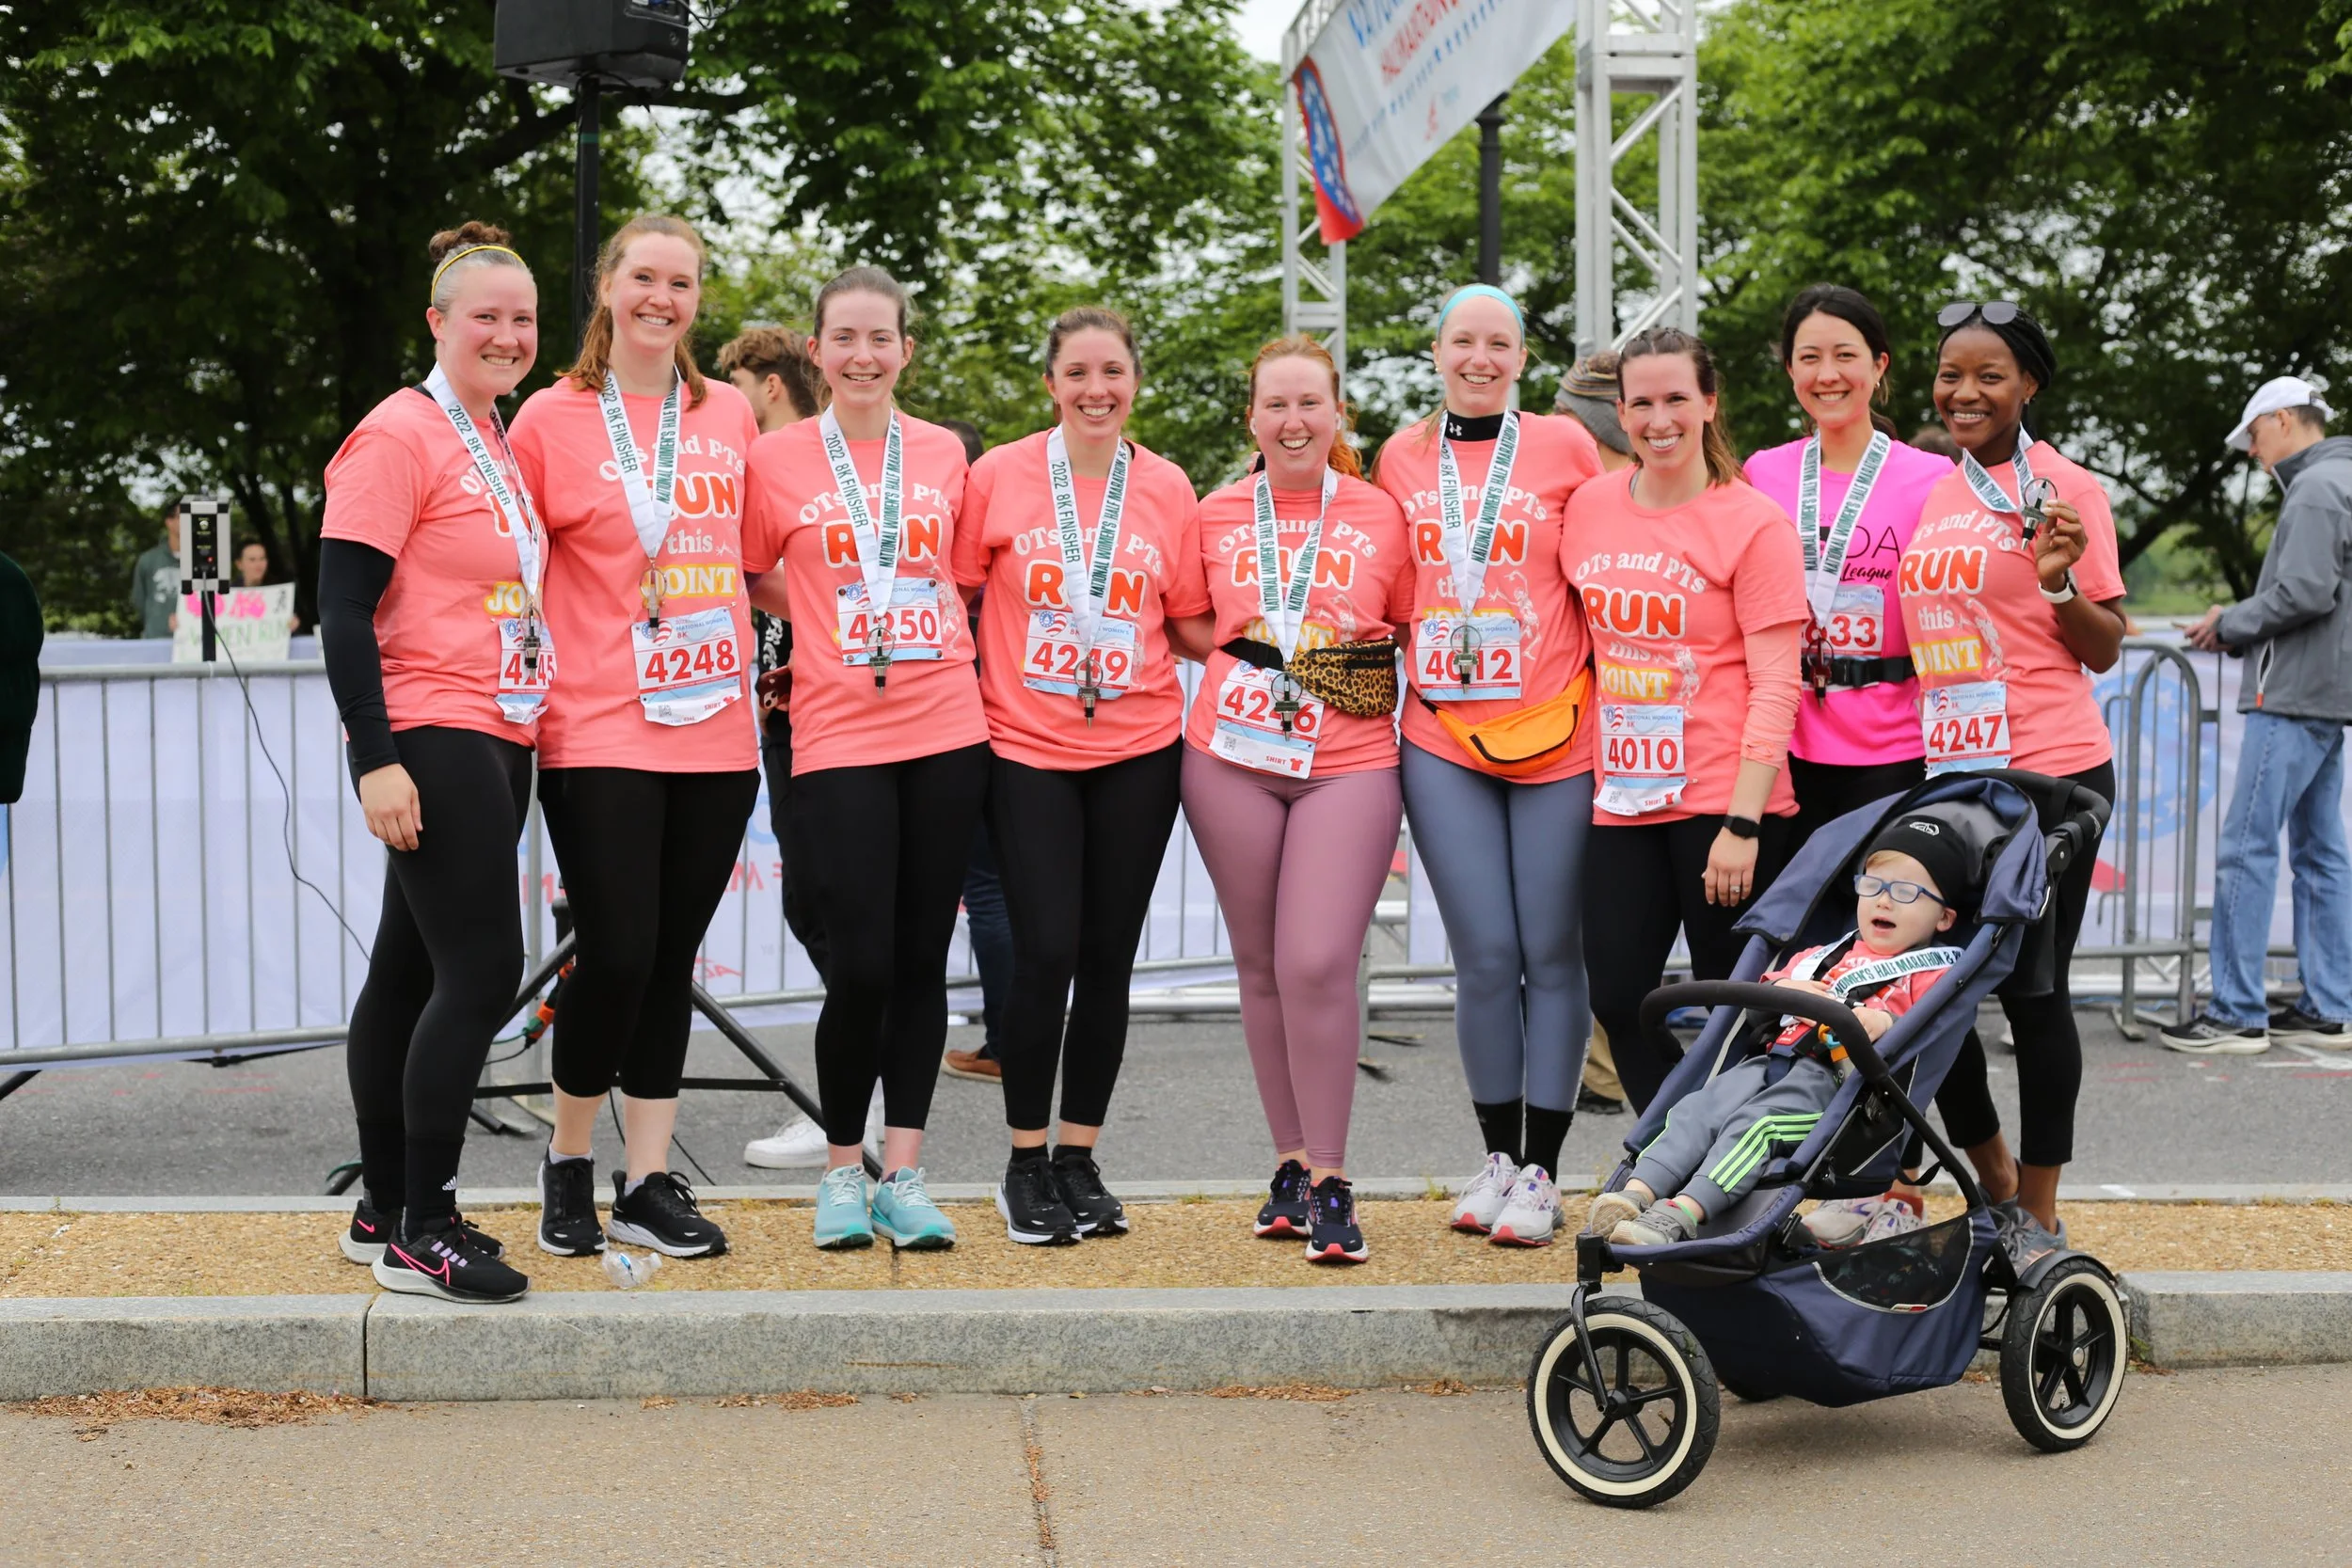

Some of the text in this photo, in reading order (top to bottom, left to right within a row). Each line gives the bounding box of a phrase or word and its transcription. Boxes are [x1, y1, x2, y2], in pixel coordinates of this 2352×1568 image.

[607, 406, 624, 423] 8K
[660, 411, 677, 428] HALF
[448, 405, 472, 435] 2022
[467, 436, 484, 453] 8K
[477, 452, 511, 506] FINISHER
[599, 447, 649, 482] Os
[707, 437, 746, 475] PTs
[611, 422, 638, 474] FINISHER
[886, 431, 902, 472] MARATHON
[1495, 424, 1518, 468] MARATHON
[656, 468, 674, 504] NATIONAL
[825, 433, 868, 528] 2022 8K FINISHER
[885, 472, 902, 491] HALF
[1108, 459, 1127, 502] MARATHON
[1440, 463, 1455, 477] 8K
[1490, 467, 1508, 486] HALF
[799, 492, 845, 524] OTs
[1052, 461, 1080, 563] 2022 8K FINISHER
[1104, 499, 1120, 521] HALF
[1256, 483, 1272, 522] MARATHON
[1441, 479, 1461, 530] FINISHER
[1504, 484, 1547, 521] PTs
[666, 528, 713, 555] this
[821, 514, 942, 568] RN
[1259, 522, 1275, 540] HALF
[1330, 520, 1377, 558] PTs
[1415, 518, 1530, 566] RN
[1470, 525, 1493, 564] NATIONAL
[1823, 537, 1847, 575] NATIONAL
[1850, 483, 1869, 502] HALF
[1937, 509, 1979, 532] and
[1973, 514, 2017, 552] PTs
[879, 531, 898, 568] NATIONAL
[1014, 527, 1059, 555] OTs
[1124, 533, 1163, 576] PTs
[1025, 559, 1147, 618] RN
[1089, 561, 1110, 598] NATIONAL
[1437, 575, 1486, 598] ths
[1575, 551, 1708, 594] OTs and PTs
[1840, 562, 1893, 582] League
[1898, 545, 1988, 597] RUN
[1263, 576, 1280, 612] NATIONAL
[1288, 576, 1310, 612] NATIONAL
[1579, 582, 1686, 640] RUN
[848, 610, 937, 644] 4250
[1244, 617, 1336, 651] JONT
[1917, 605, 1956, 631] this
[644, 639, 736, 683] 4248
[1031, 641, 1129, 681] 4249
[1425, 649, 1513, 681] 4012
[1929, 715, 2003, 753] 4247
[1265, 755, 1287, 765] SHIRT
[1608, 737, 1678, 770] 4010
[1836, 966, 1875, 995] WOMEN'S
[1874, 961, 1898, 979] HALF
[1895, 949, 1943, 974] MARATHON
[1944, 952, 1954, 964] &
